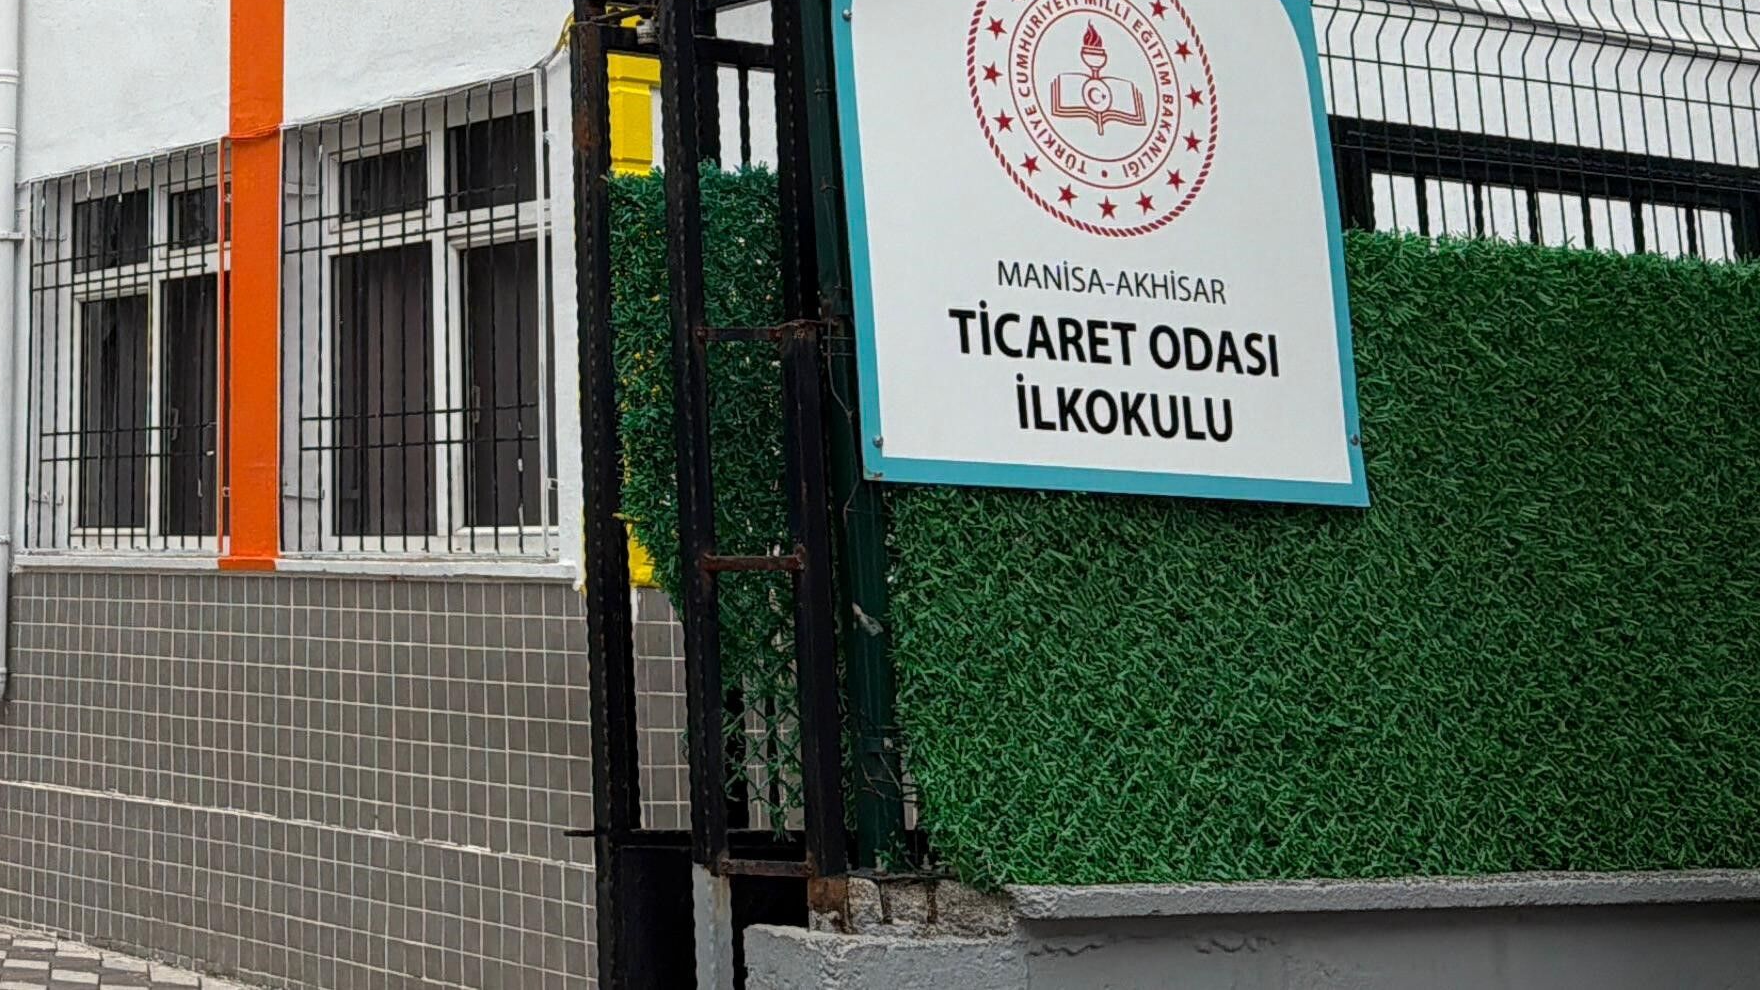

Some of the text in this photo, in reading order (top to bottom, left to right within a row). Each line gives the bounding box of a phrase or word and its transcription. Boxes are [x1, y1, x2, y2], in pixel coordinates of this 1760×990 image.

[1133, 19, 1173, 87] EĞİTİM
[1025, 104, 1088, 176] TÜRKİYE
[1123, 93, 1175, 179] BAKANLIĞI
[997, 260, 1228, 305] MANİSA-AKHİSAR
[949, 300, 1280, 378] TİCARET ODASI
[1016, 374, 1235, 442] İLKOKULU
